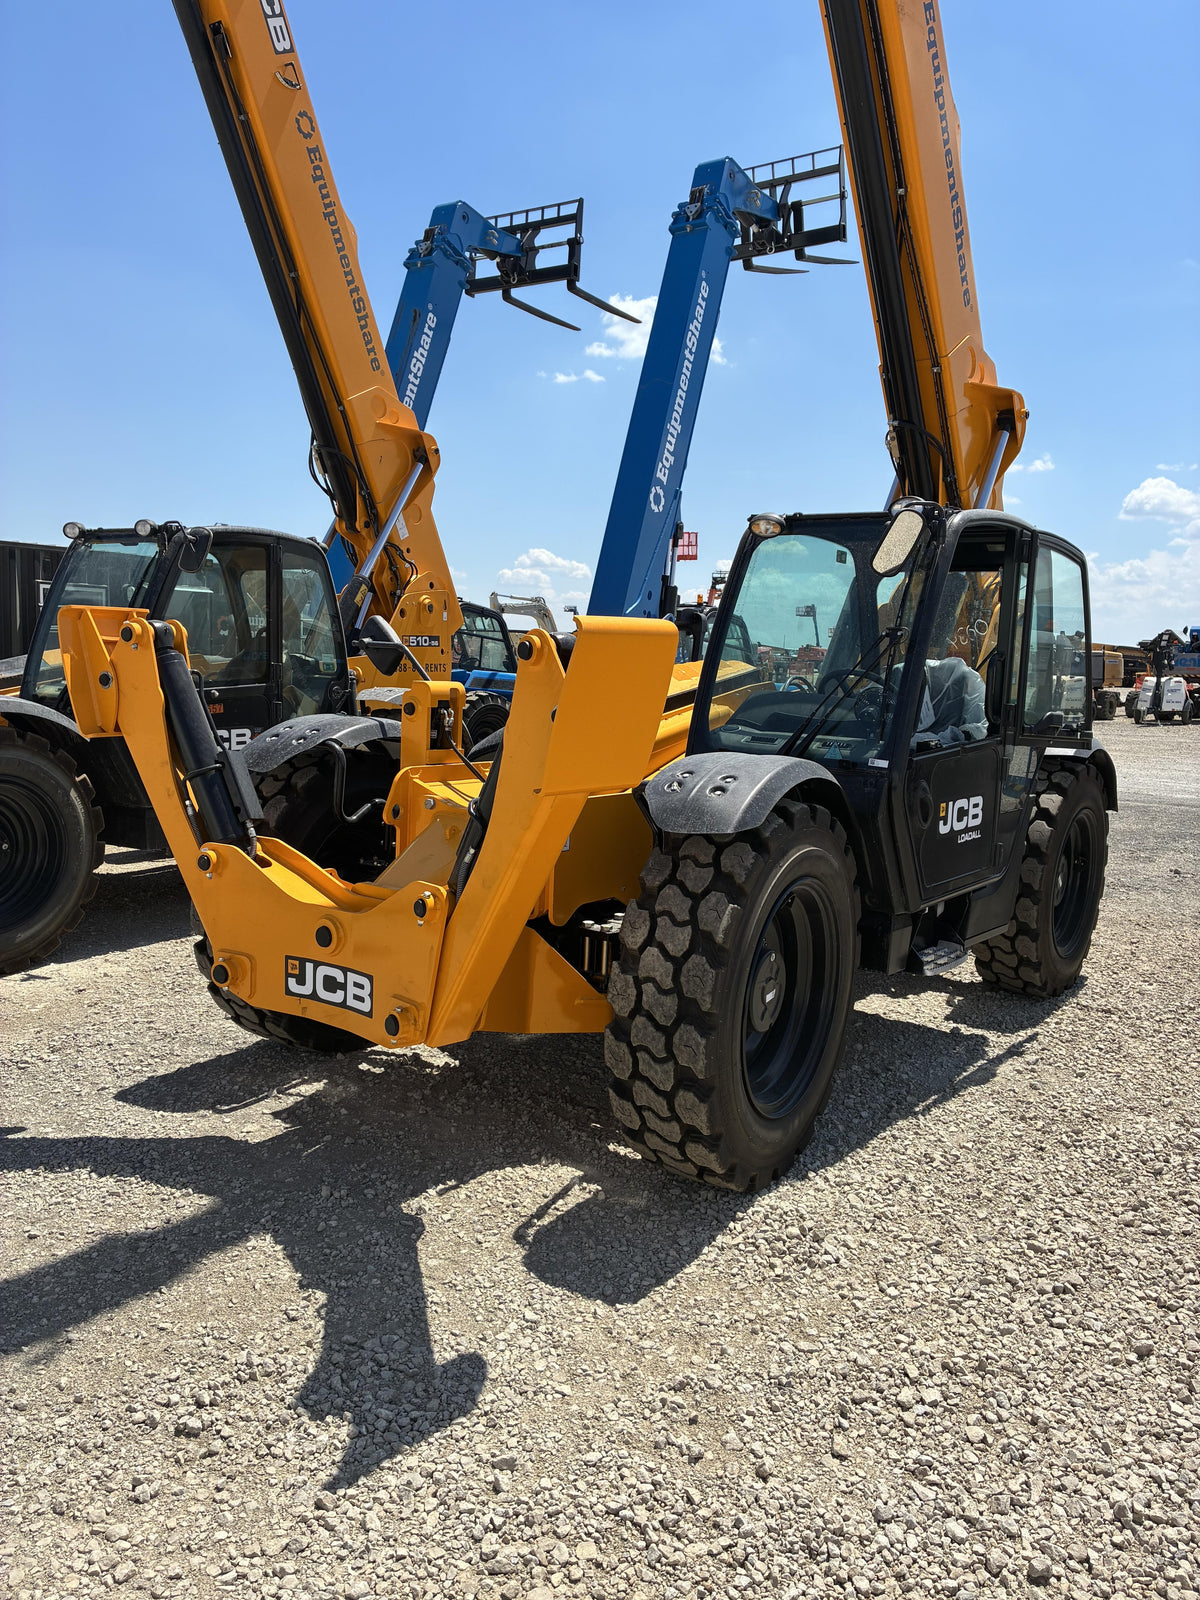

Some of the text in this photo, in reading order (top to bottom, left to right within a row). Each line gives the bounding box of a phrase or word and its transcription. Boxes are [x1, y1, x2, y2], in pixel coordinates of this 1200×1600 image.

[261, 0, 291, 52] CB
[923, 0, 971, 308] EquipmentShare
[306, 145, 381, 372] EquipmentShare
[403, 311, 437, 410] entShare
[656, 277, 709, 486] EquipmentShare
[1174, 654, 1200, 667] eni
[216, 728, 252, 751] CB
[939, 795, 984, 835] JCB
[957, 829, 982, 844] LOADALL
[287, 960, 373, 1013] JCB
